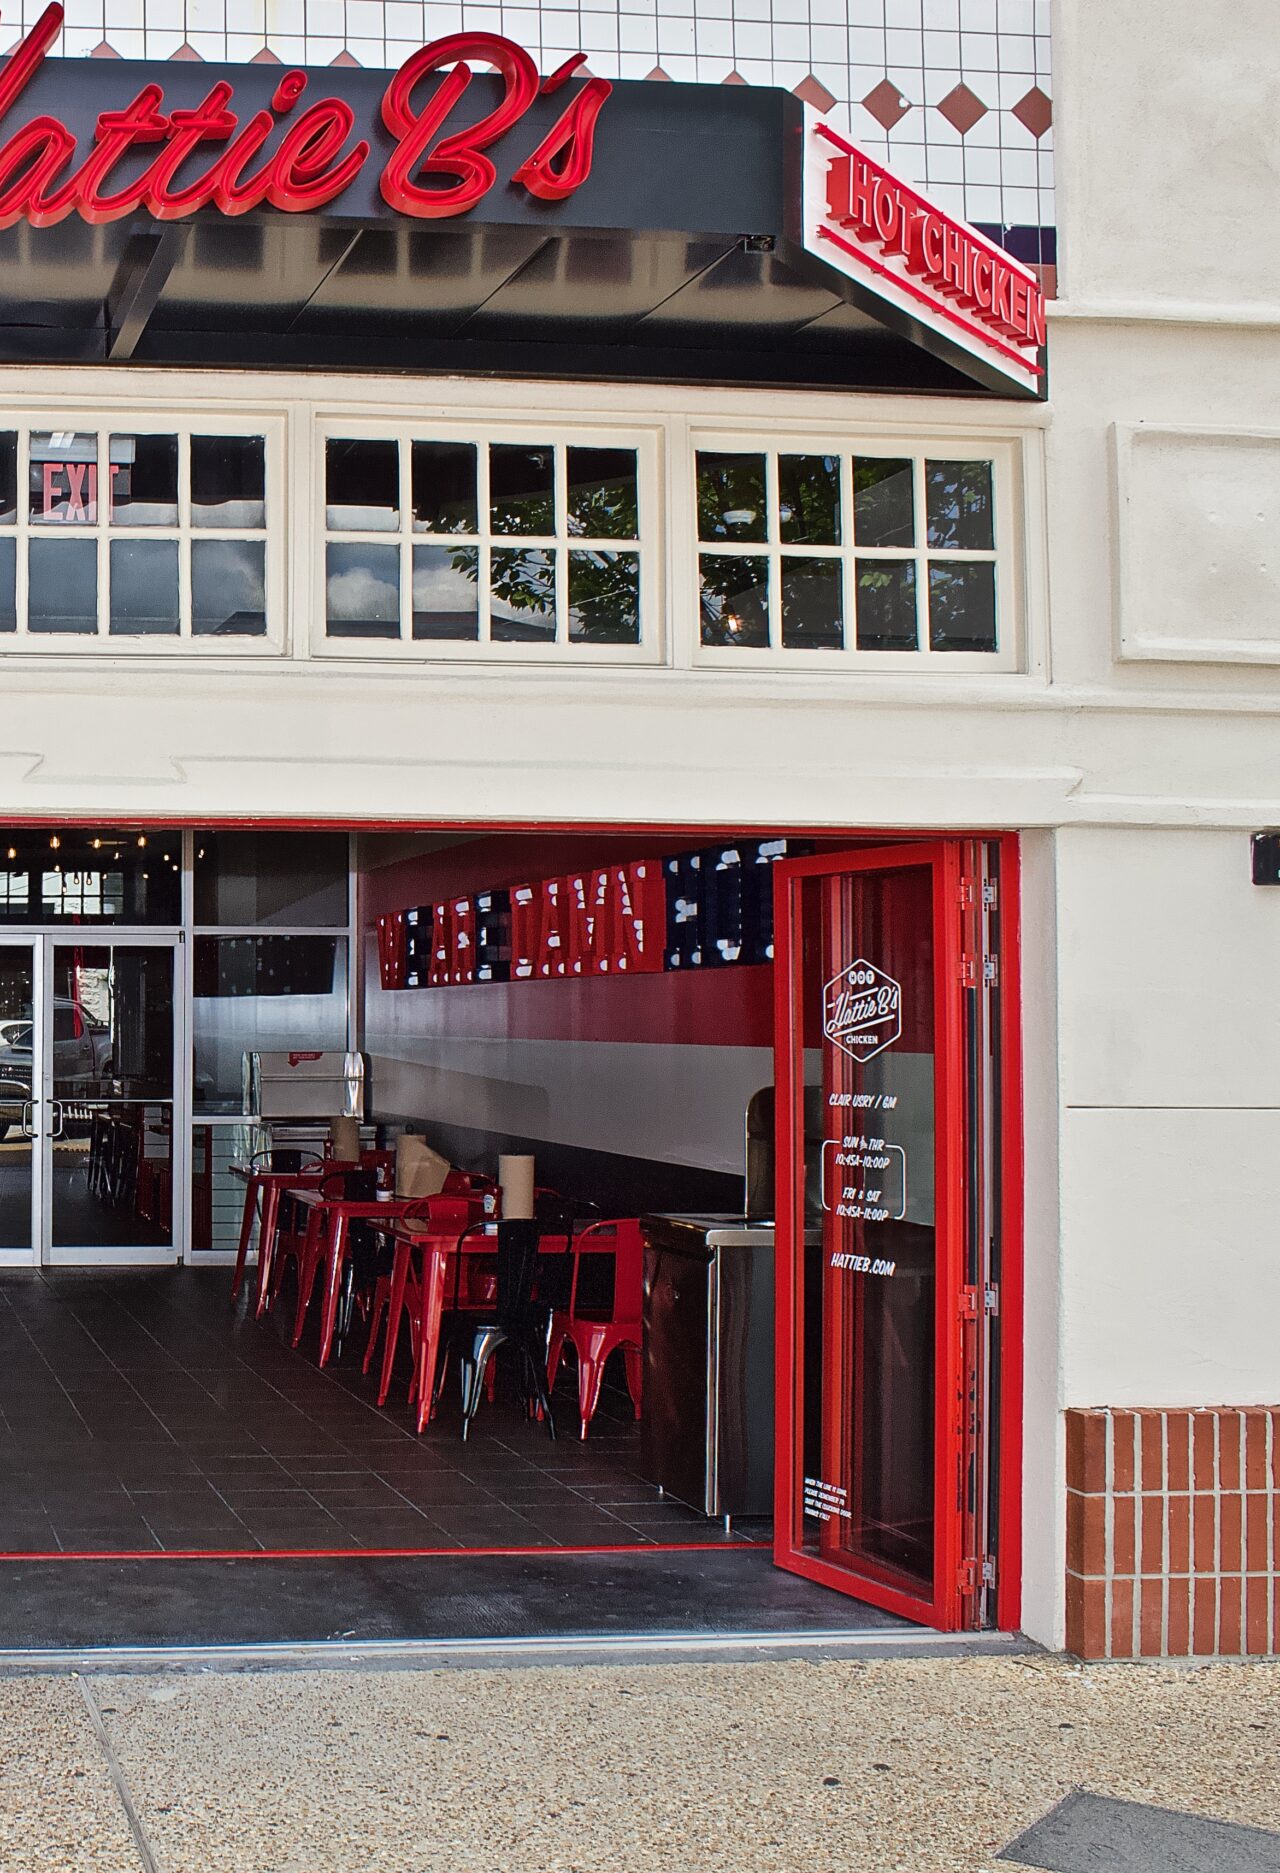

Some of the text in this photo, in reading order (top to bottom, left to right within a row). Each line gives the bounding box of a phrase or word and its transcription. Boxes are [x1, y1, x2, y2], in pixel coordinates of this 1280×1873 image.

[380, 31, 613, 219] B's
[826, 154, 1046, 347] HOT CHICKEN
[848, 970, 875, 985] HOT
[827, 986, 898, 1033] Hattie B's
[846, 1035, 878, 1044] CHICKEN
[829, 1093, 851, 1107] CLAIR
[852, 1094, 875, 1107] USRY
[882, 1095, 897, 1109] GM
[843, 1136, 885, 1151] SUN THR
[842, 1187, 856, 1200] FRI
[866, 1190, 882, 1202] SAT
[831, 1252, 896, 1276] HATTIEB.COM
